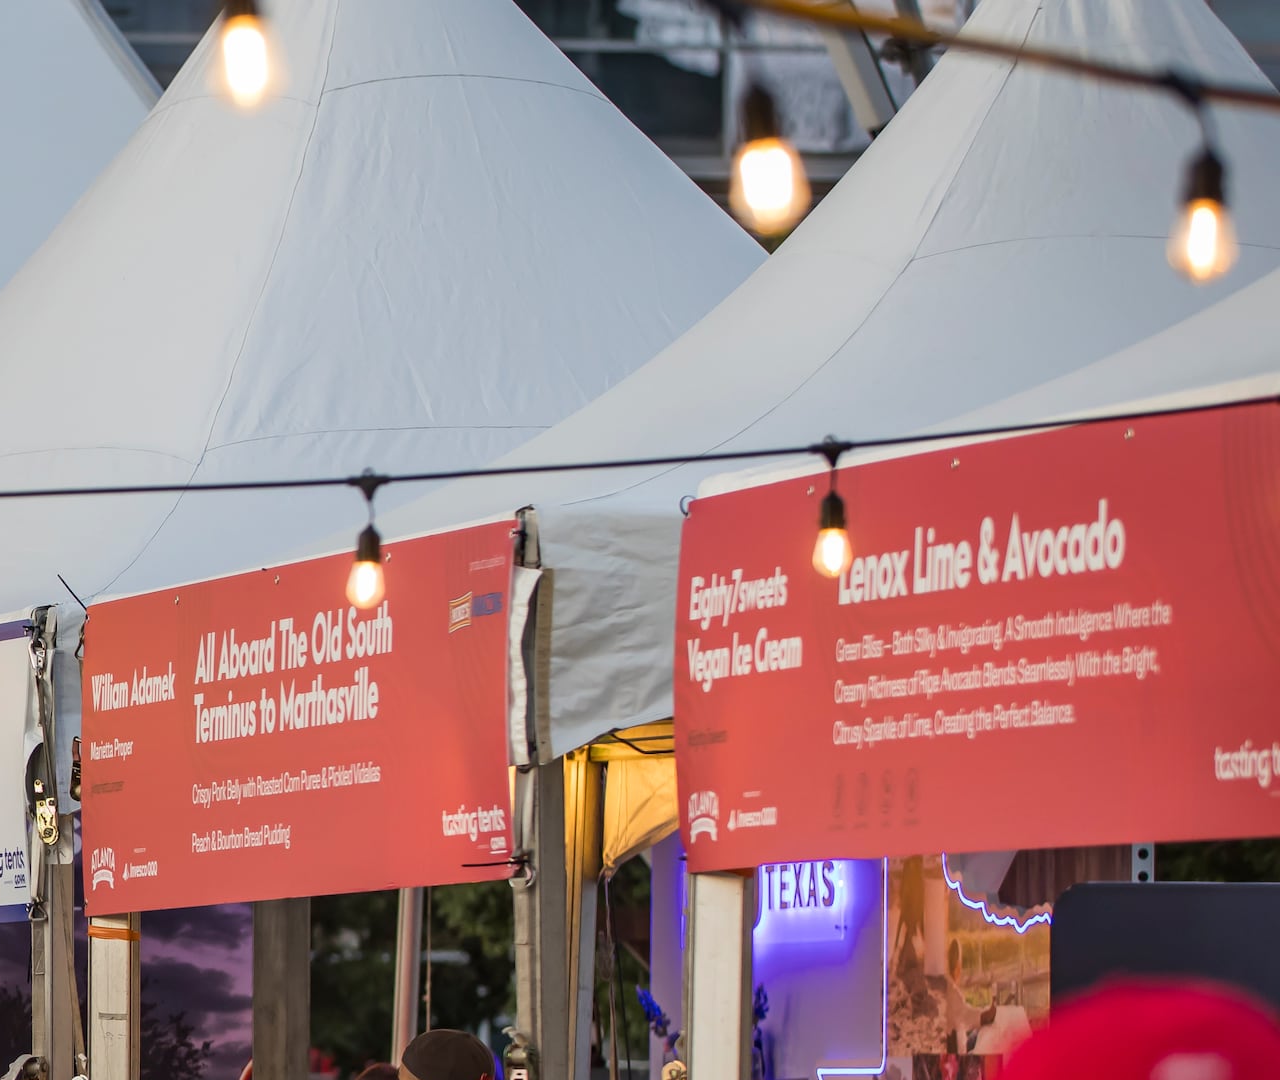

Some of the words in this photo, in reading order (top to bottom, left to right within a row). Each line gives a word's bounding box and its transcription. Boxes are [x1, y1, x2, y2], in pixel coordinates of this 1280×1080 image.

[913, 526, 972, 594] Lime
[977, 517, 999, 585] &
[1001, 498, 1126, 582] Avocado
[194, 631, 215, 685] All
[217, 620, 275, 681] Aboard
[279, 617, 308, 671] The
[312, 608, 343, 665] Old
[345, 600, 393, 660] South
[892, 630, 914, 655] Both
[1004, 617, 1014, 641] A
[1014, 611, 1054, 641] Smooth
[1056, 607, 1113, 641] Indulgence
[1113, 602, 1151, 629] Where
[1151, 597, 1172, 625] the
[688, 638, 730, 692] Vegan
[732, 632, 752, 677] Ice
[754, 627, 802, 673] Cream
[940, 664, 982, 691] Avocado
[982, 661, 1017, 687] Blends
[1075, 650, 1101, 677] With
[1102, 648, 1121, 675] the
[91, 672, 129, 713] William
[130, 661, 176, 707] Adamek
[194, 689, 257, 744] Terminus
[260, 688, 276, 734] to
[279, 666, 379, 732] Marthasville
[975, 706, 992, 731] the
[993, 702, 1030, 730] Perfect
[90, 740, 113, 761] Marietta
[114, 738, 134, 761] Proper
[192, 783, 212, 809] Crispy
[212, 780, 227, 802] Pork
[227, 779, 242, 805] Belly
[242, 777, 257, 798] with
[257, 773, 284, 796] Roasted
[284, 772, 300, 793] Corn
[301, 770, 321, 791] Puree
[321, 767, 328, 788] &
[328, 764, 353, 787] Pickled
[192, 831, 211, 853] Peach
[211, 830, 217, 851] &
[217, 829, 243, 850] Bourbon
[244, 826, 263, 847] Bread
[264, 823, 290, 849] Pudding
[478, 804, 506, 832] tents
[5, 846, 25, 870] tents
[91, 847, 115, 874] ATLANTA
[765, 860, 835, 910] TEXAS
